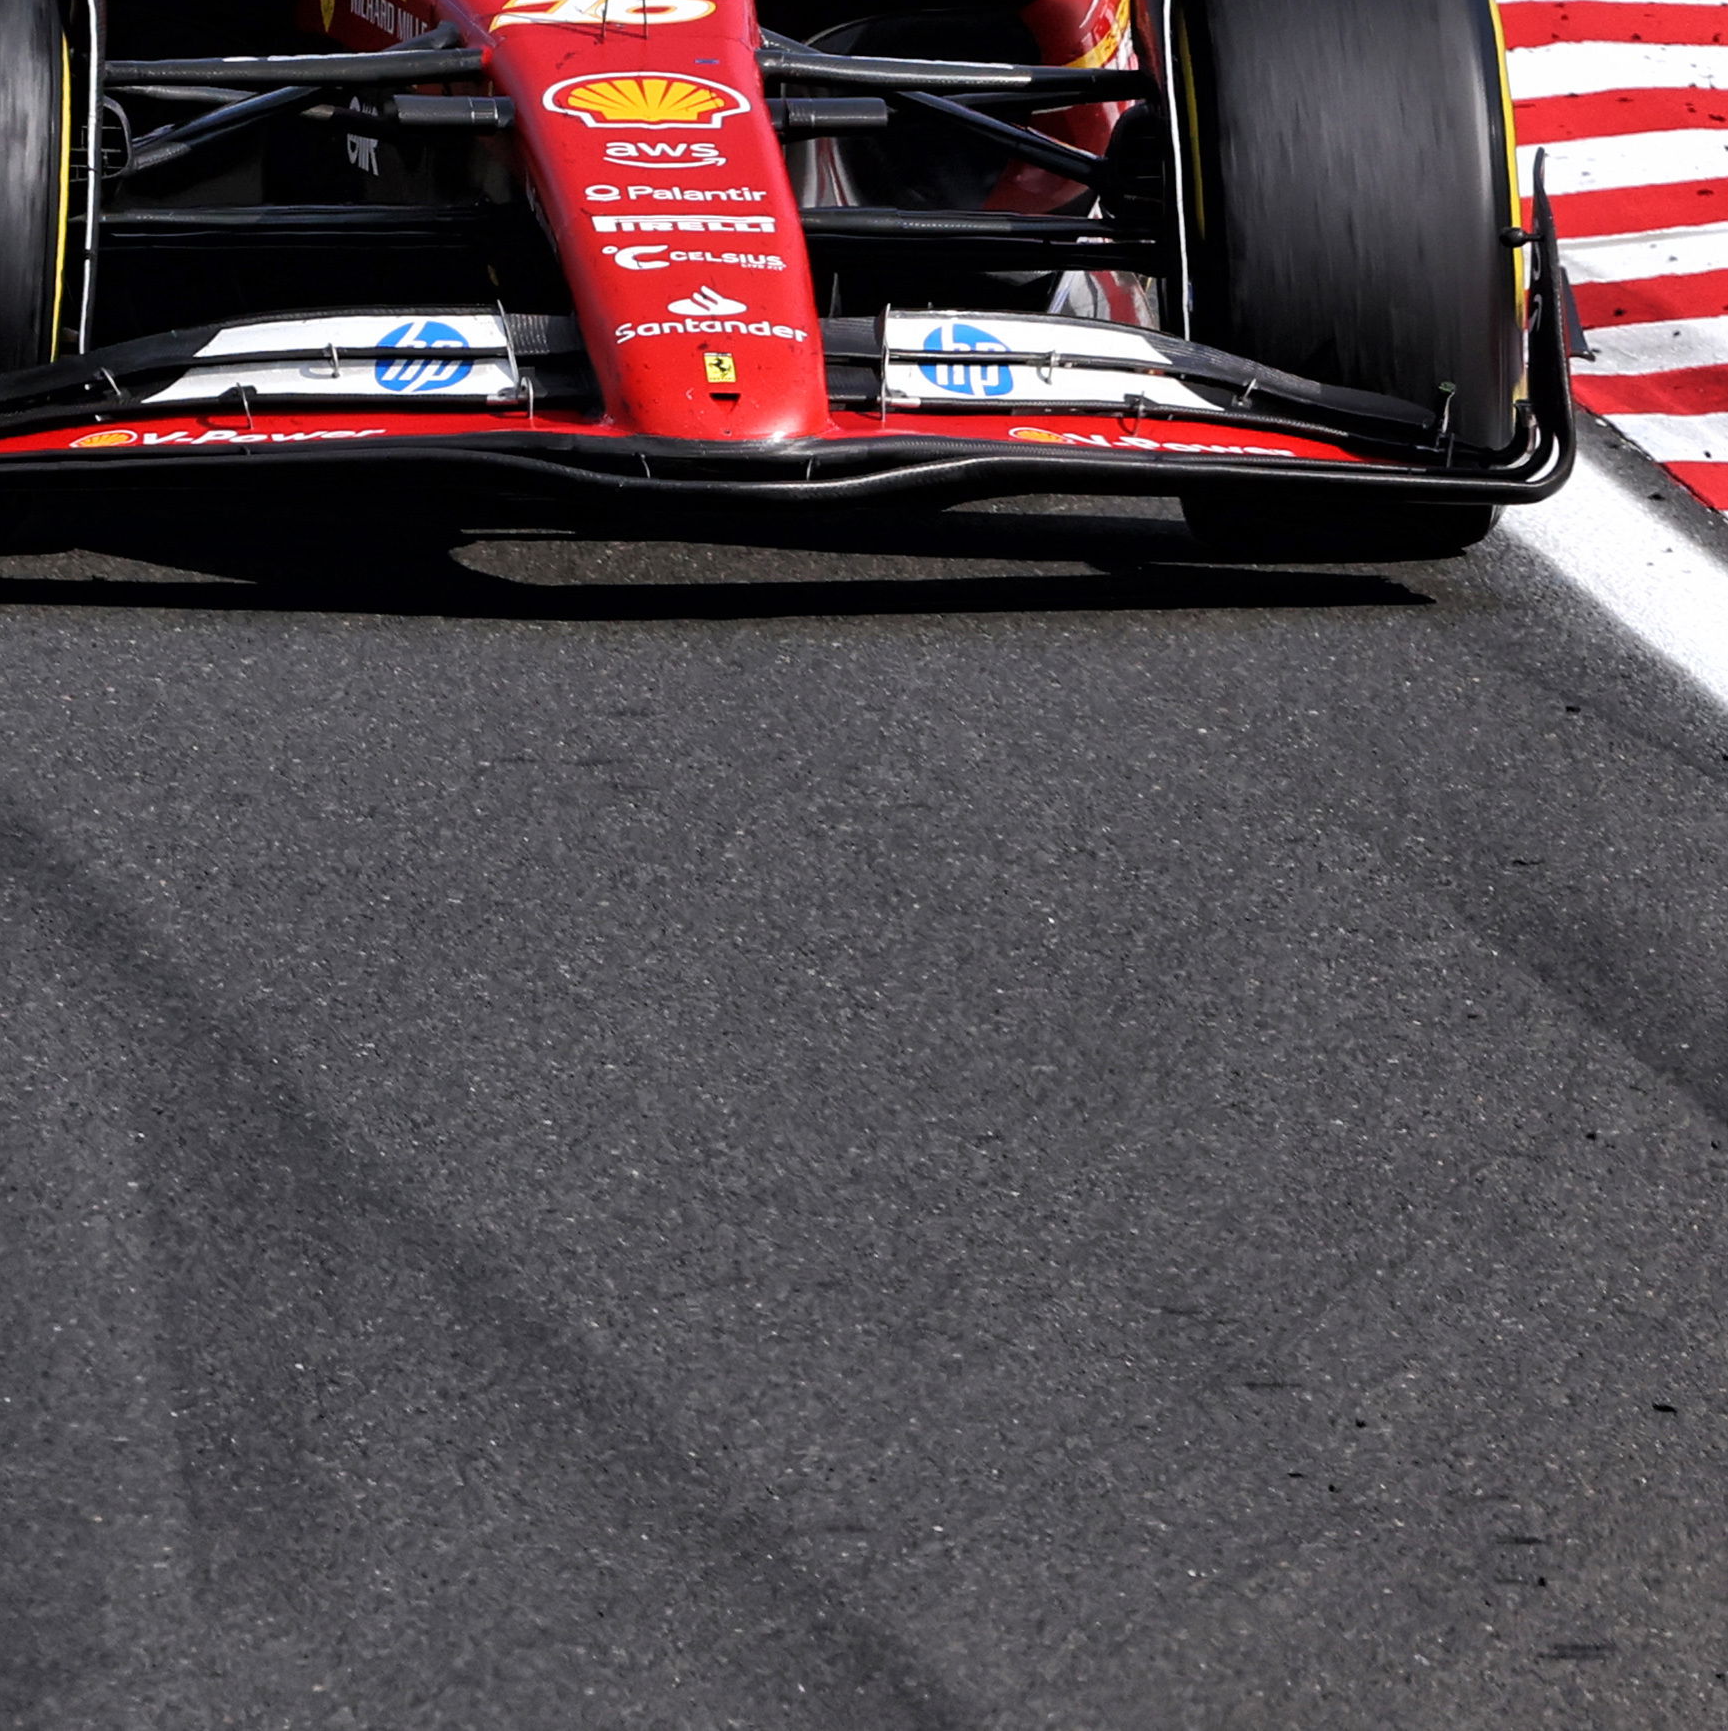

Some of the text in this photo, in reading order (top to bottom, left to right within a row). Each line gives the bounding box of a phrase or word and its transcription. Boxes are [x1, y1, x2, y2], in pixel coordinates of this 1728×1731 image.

[605, 141, 721, 159] aws
[627, 185, 768, 202] Palantir
[591, 214, 776, 233] PIRELLI
[669, 250, 784, 266] CELSIUS
[614, 318, 808, 345] Santander
[142, 428, 386, 446] V-Power
[1067, 433, 1296, 457] V-Power
